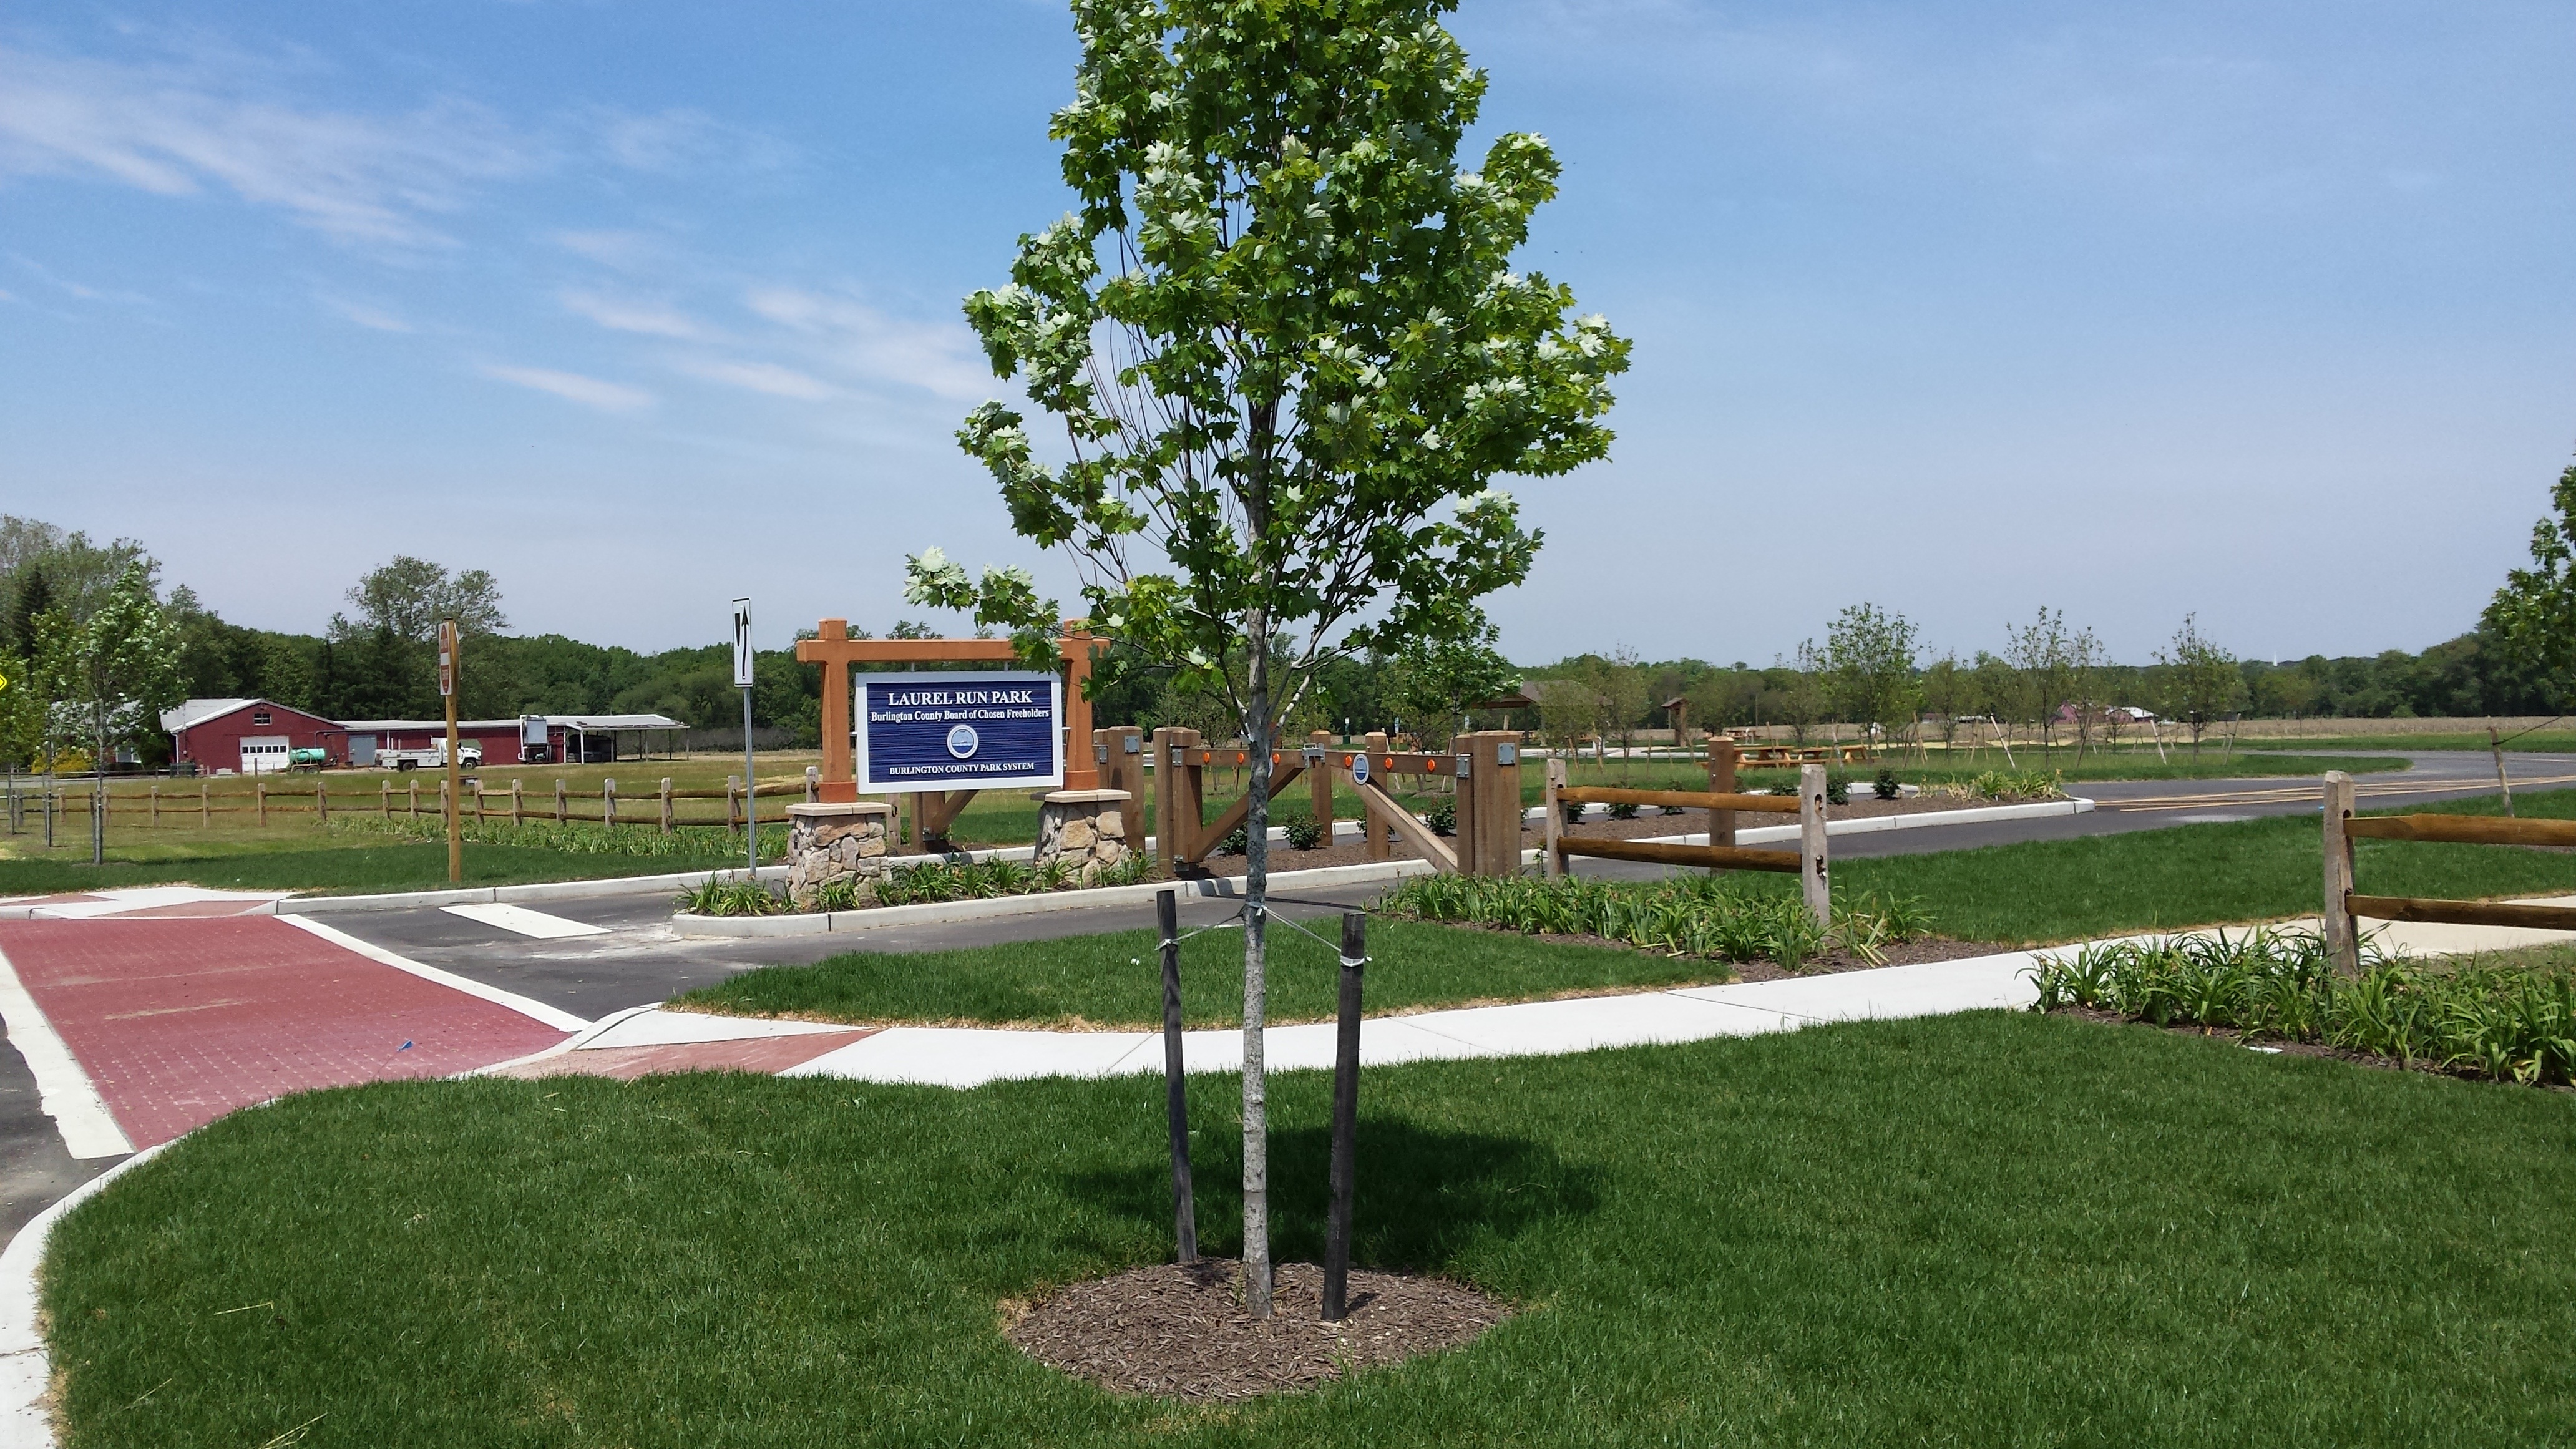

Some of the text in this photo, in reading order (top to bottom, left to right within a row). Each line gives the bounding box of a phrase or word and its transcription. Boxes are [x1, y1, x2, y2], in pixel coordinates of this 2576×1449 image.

[888, 690, 1033, 706] LAUREL RUN PARK
[871, 708, 1049, 723] Burlington County Board of Chosen Freeholders
[889, 762, 1035, 775] BURLINGTON COUNTY PARK SYSTEM
